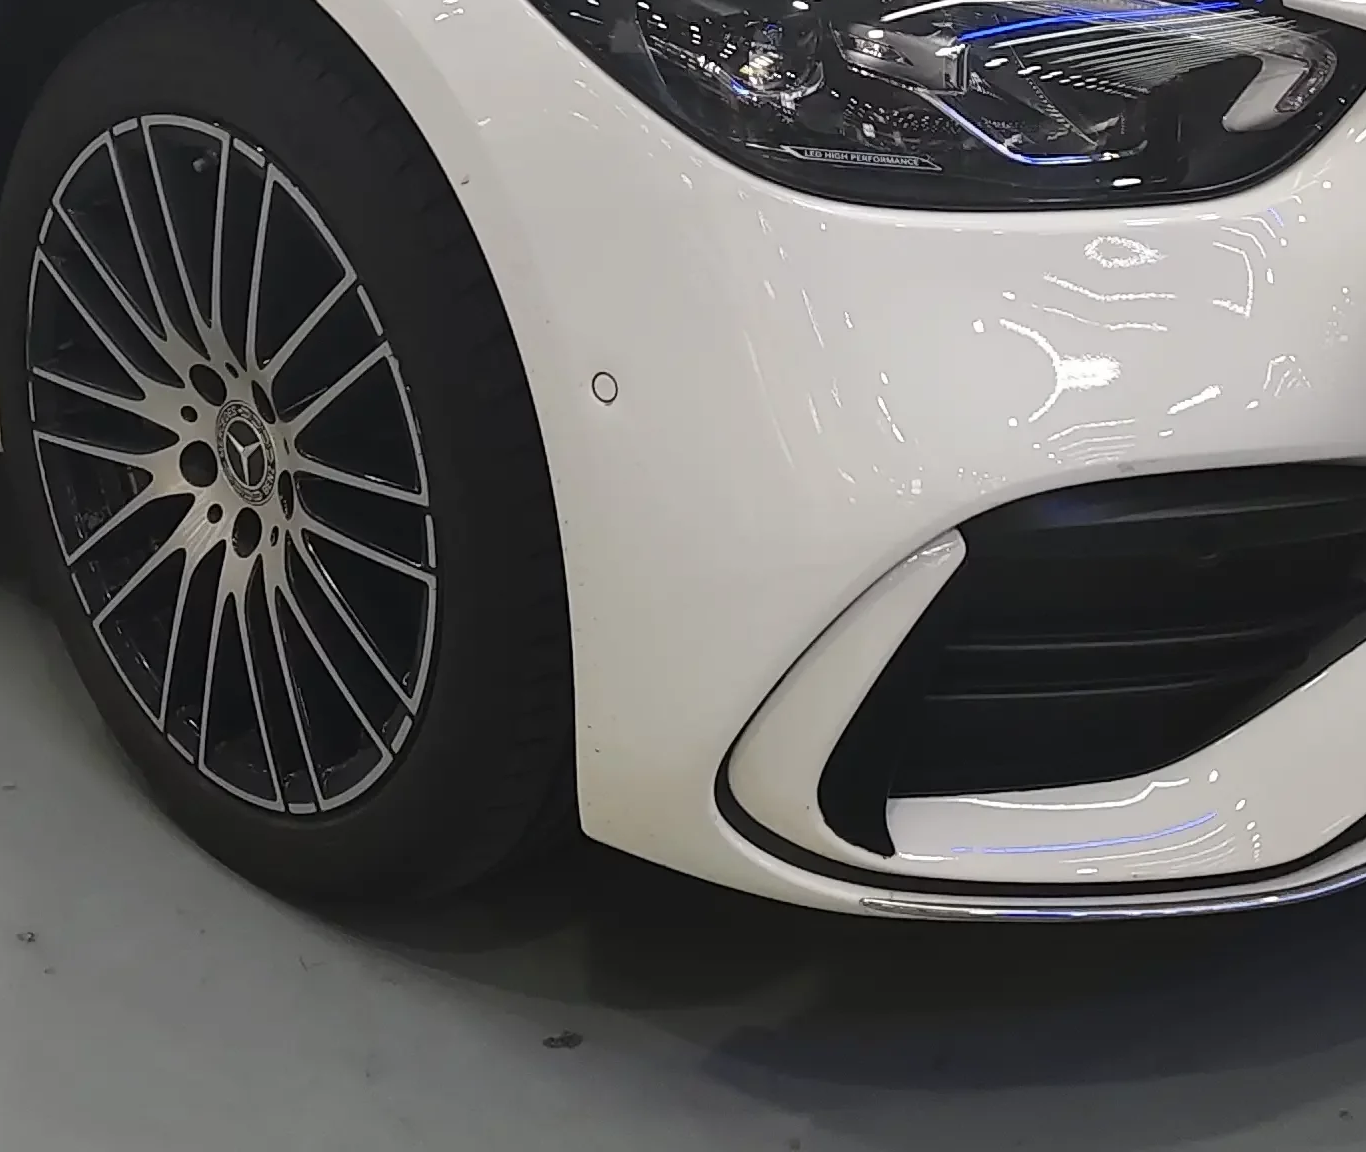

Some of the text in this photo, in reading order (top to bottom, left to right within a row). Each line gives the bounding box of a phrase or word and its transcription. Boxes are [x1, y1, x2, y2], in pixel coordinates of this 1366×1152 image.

[804, 149, 920, 167] LED HIGH PERFORMANCE
